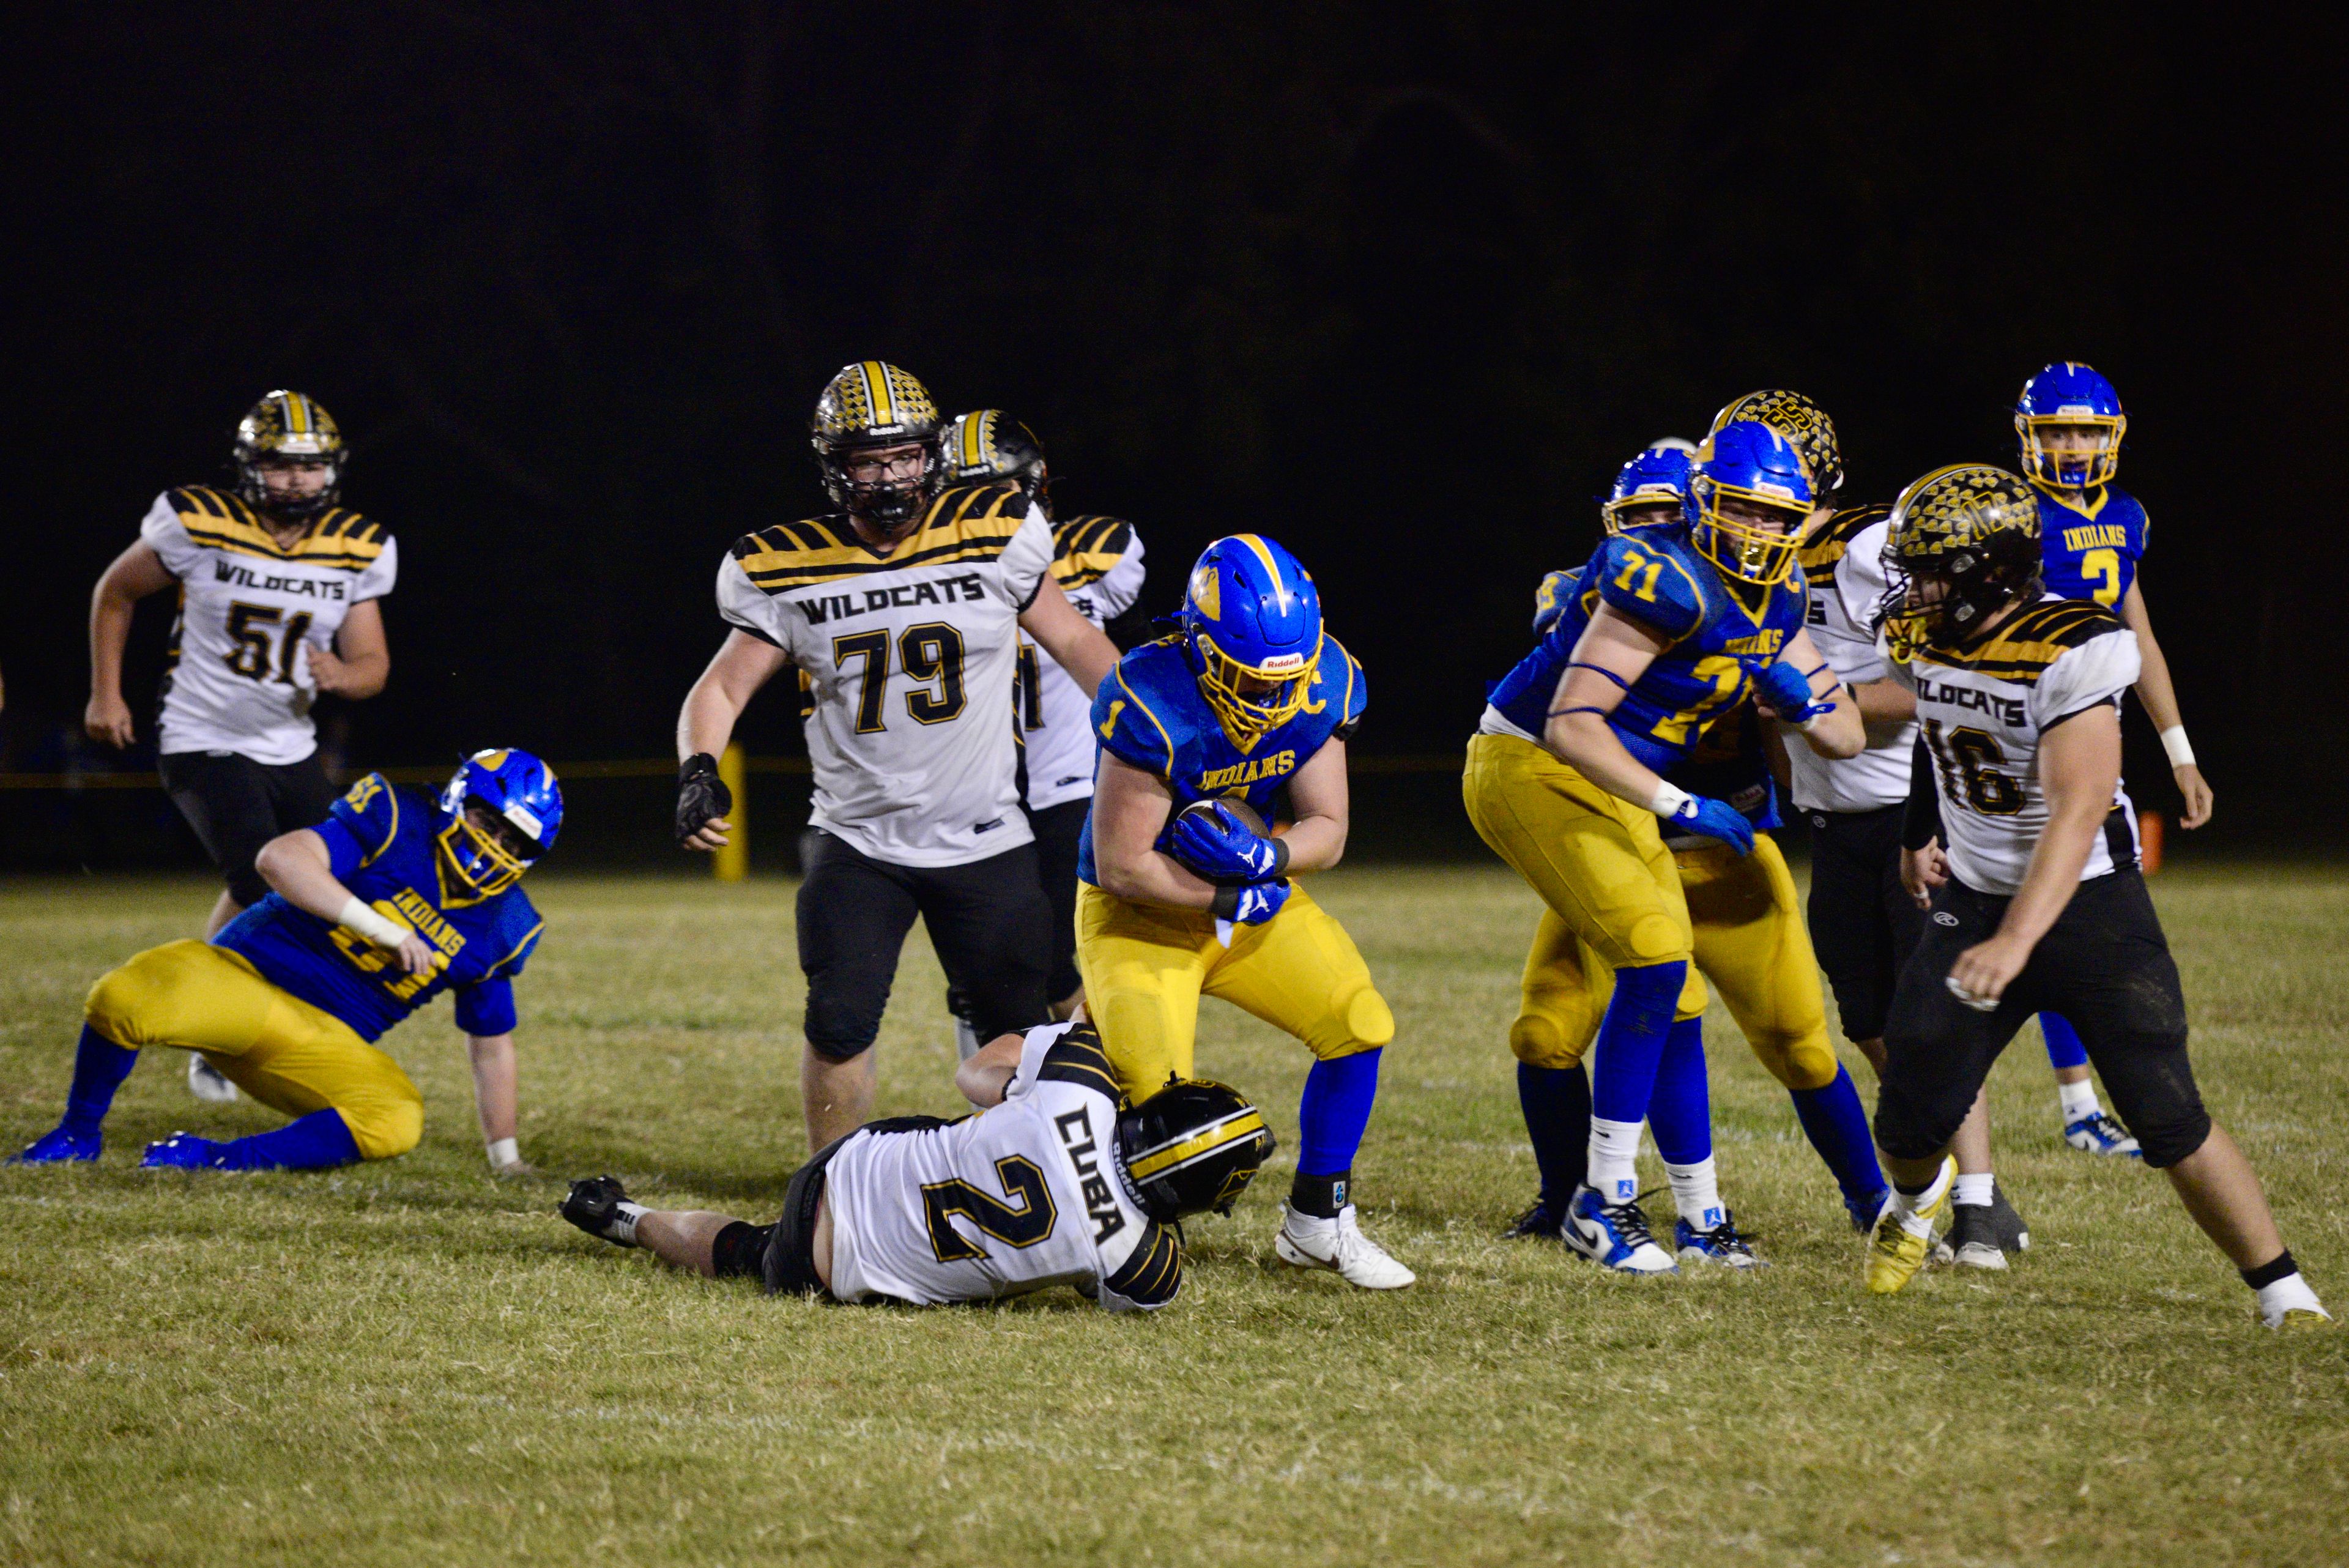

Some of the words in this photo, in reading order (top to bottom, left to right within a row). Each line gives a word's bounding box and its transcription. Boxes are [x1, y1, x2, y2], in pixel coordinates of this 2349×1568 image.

[2063, 524, 2126, 552] INDIANS
[216, 559, 344, 600] WILDCATS
[796, 573, 985, 625] WILDCATS
[1614, 549, 1663, 603] 71
[221, 600, 313, 685] 51
[1267, 656, 1300, 669] Riddell
[832, 621, 967, 735] 79
[1916, 677, 2027, 727] ILDCATS
[1099, 700, 1126, 740] 1
[1195, 749, 1296, 791] INDIANS
[1925, 718, 2027, 816] 16
[392, 886, 467, 957] INDIANS
[1053, 1101, 1126, 1247] CUBA
[920, 1153, 1058, 1263] 2
